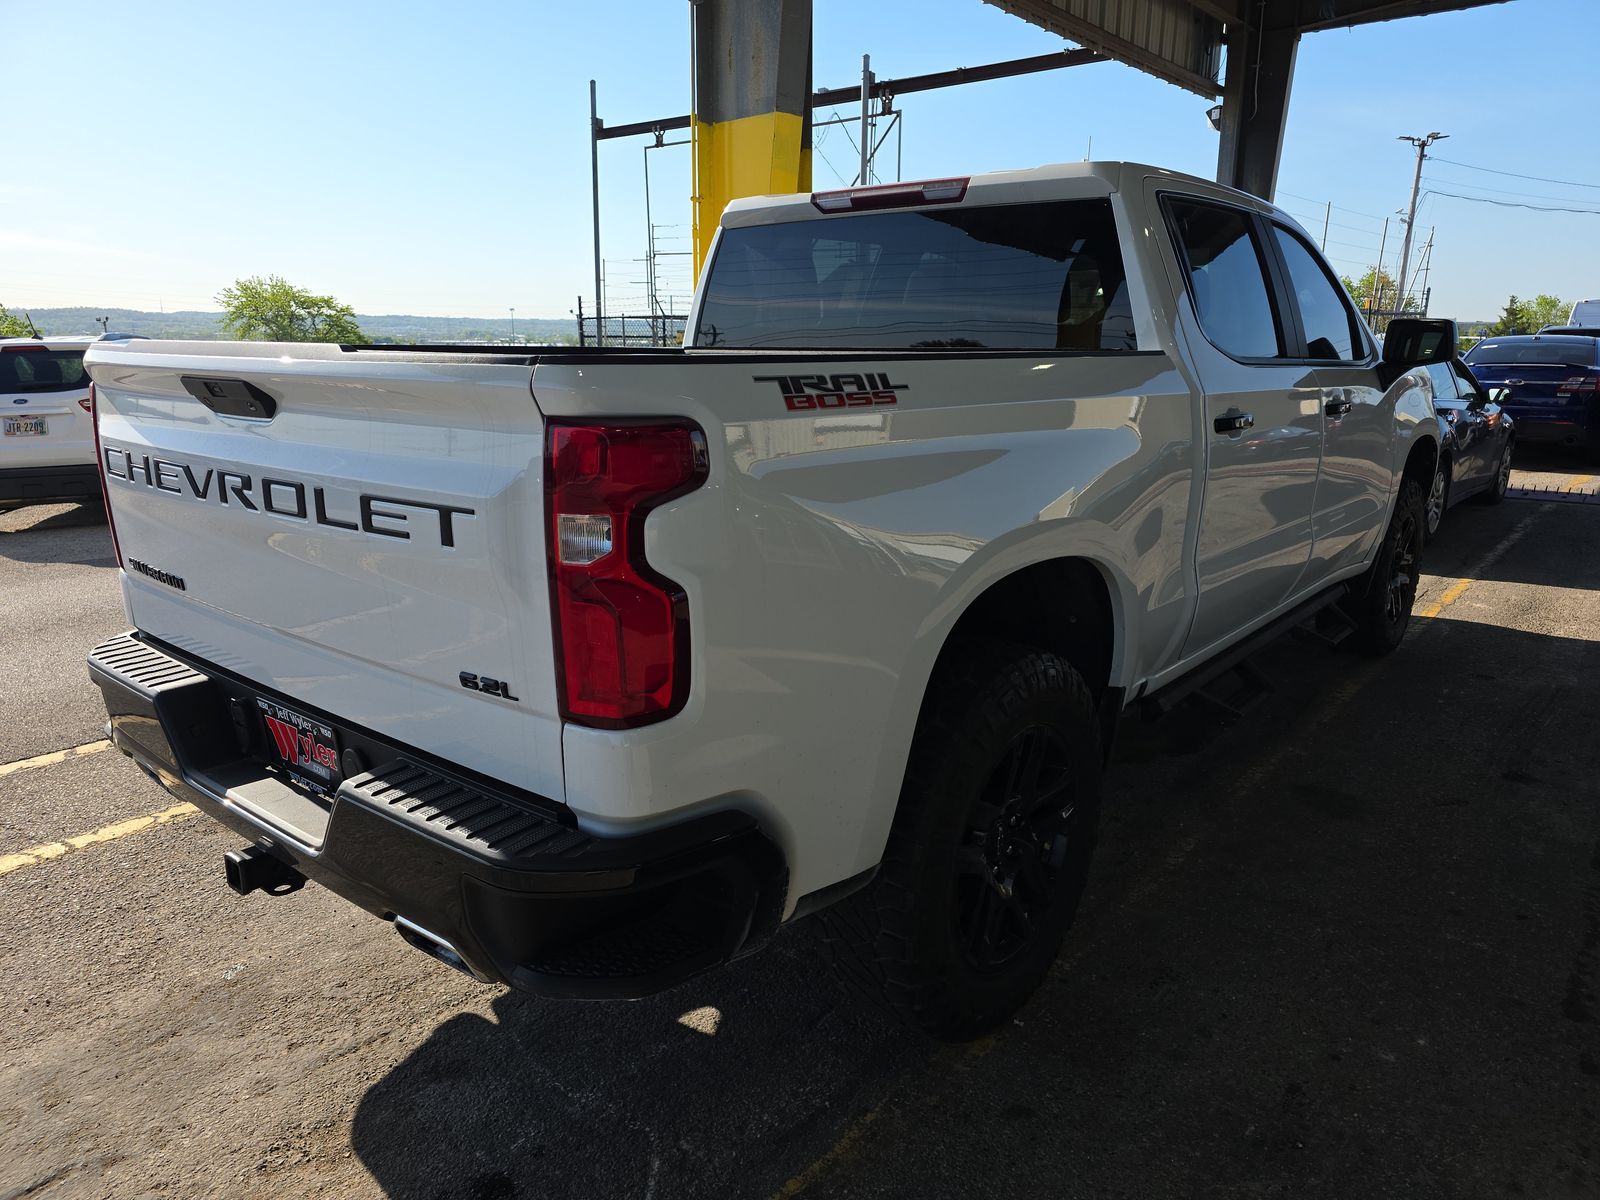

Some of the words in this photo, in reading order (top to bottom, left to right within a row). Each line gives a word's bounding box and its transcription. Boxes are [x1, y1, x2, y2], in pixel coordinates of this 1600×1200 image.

[752, 372, 909, 394] TRAIL
[784, 390, 898, 411] BOSS
[6, 423, 21, 433] JTR
[24, 422, 44, 432] 2209
[103, 446, 476, 550] CHEVROLET
[276, 707, 290, 721] Jeff
[289, 713, 312, 730] Wyler
[264, 714, 338, 771] Wyler
